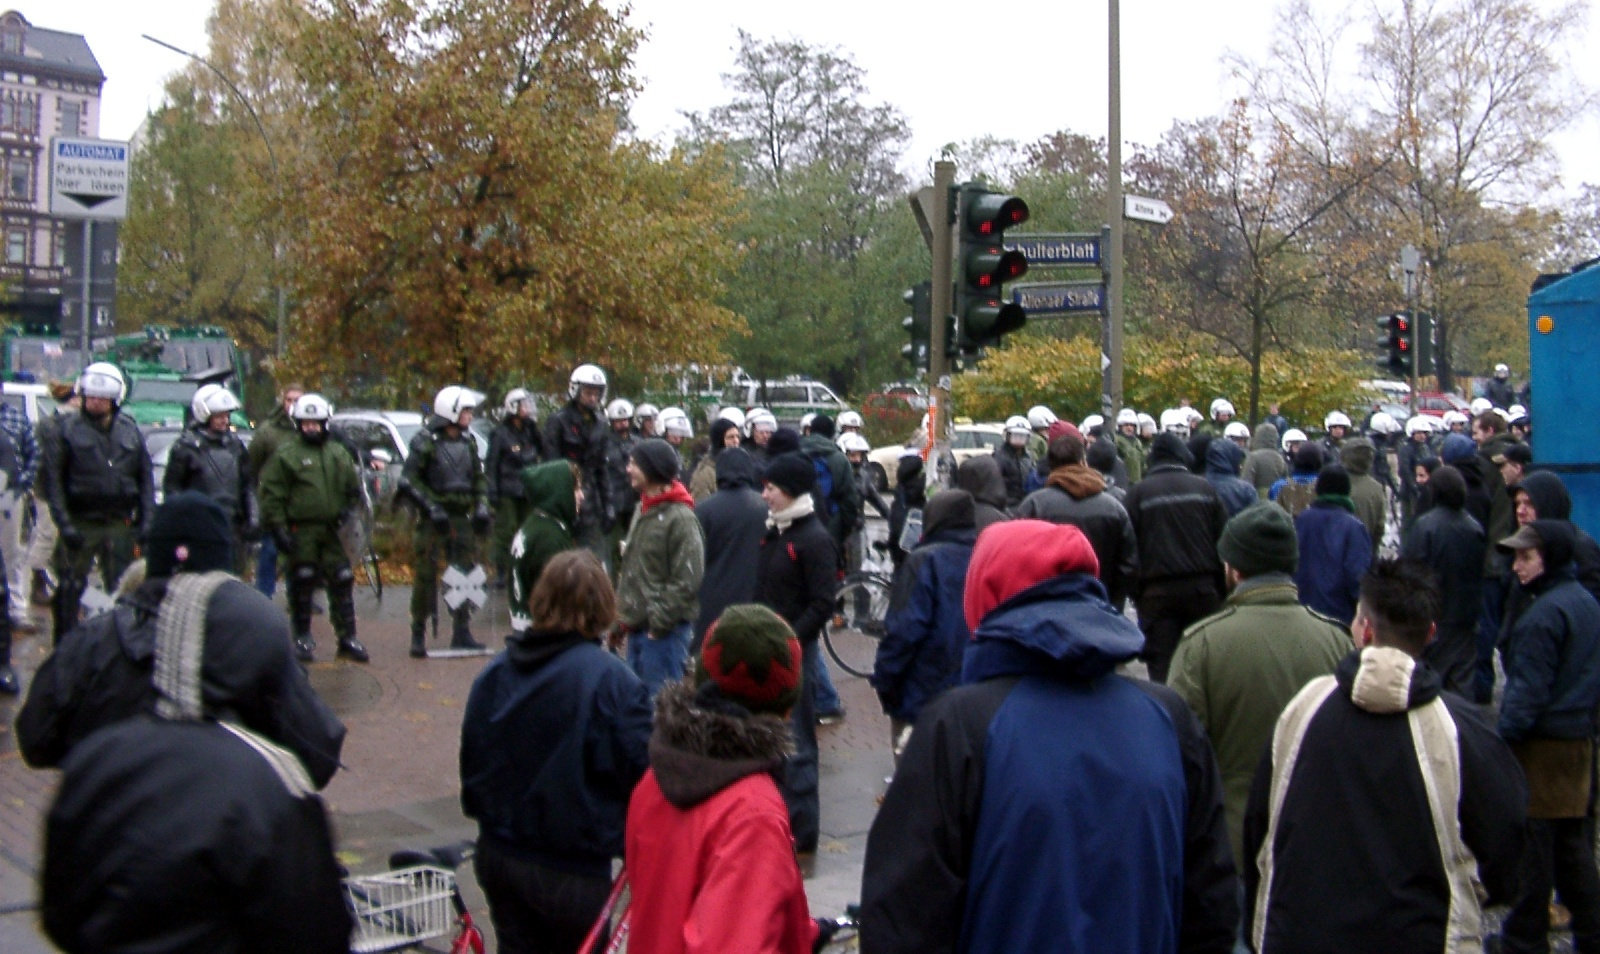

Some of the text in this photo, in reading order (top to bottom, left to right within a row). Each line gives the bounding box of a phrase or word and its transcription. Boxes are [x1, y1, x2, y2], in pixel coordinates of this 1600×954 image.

[63, 144, 120, 160] AUTOMAT
[57, 163, 124, 177] Parkschein
[56, 177, 124, 192] hier lösen
